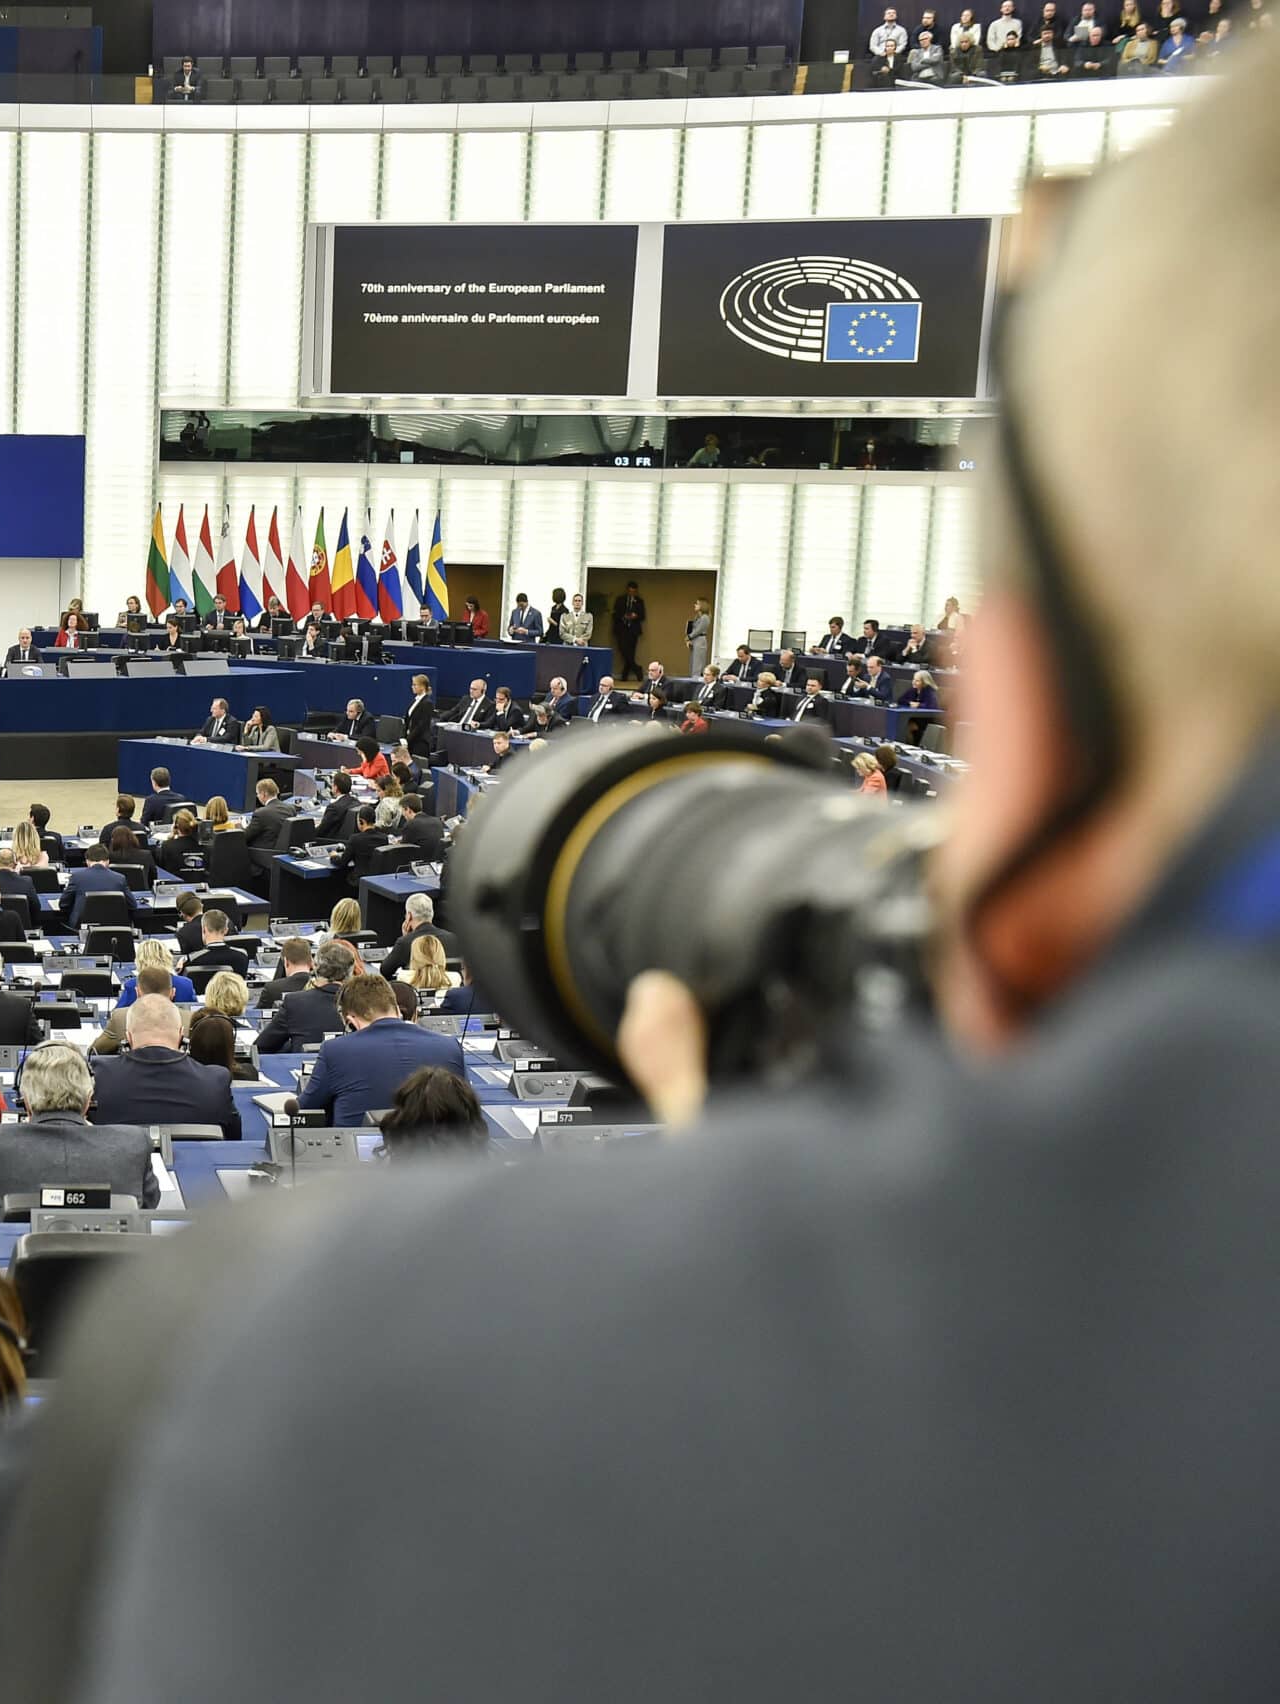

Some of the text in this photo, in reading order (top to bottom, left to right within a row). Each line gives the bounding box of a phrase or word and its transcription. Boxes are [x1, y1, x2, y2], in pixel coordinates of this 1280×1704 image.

[360, 283, 606, 295] 70th anniversary of the European Parliament
[363, 312, 600, 325] 70ème anniversaire du Parlement européen
[614, 456, 652, 467] 03 FR
[958, 460, 975, 471] 04
[291, 1116, 306, 1125] 574
[559, 1114, 573, 1122] 573
[66, 1191, 87, 1205] 662
